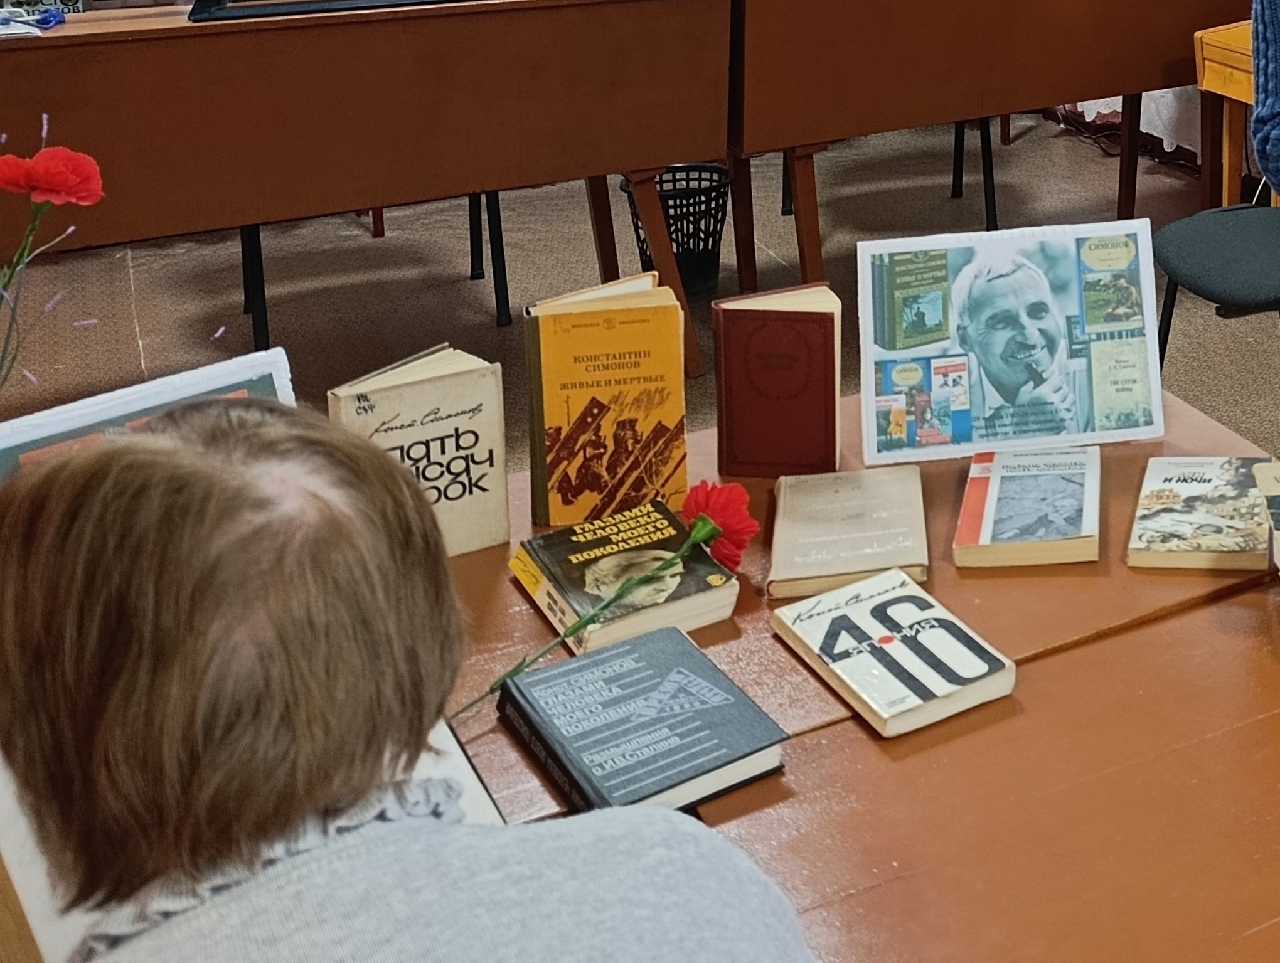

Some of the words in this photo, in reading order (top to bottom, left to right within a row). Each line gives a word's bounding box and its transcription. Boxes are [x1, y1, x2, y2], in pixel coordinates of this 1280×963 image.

[573, 350, 651, 364] КОНСТАНТИН
[585, 360, 641, 372] СИМОНОВ
[560, 380, 602, 390] ЖИВЫЕ
[604, 379, 612, 387] И
[613, 375, 666, 386] МЕРТВЫЕ
[570, 512, 664, 543] ЧЕЛОВЕКА
[572, 503, 656, 535] ГЛАЗАМИ
[609, 519, 670, 544] МОЕГО
[568, 526, 677, 564] ПОКОЛЕНИЯ
[570, 658, 637, 685] СИМОНОВ
[539, 681, 606, 707] ГЛАЗАМИ
[546, 687, 624, 717] ЧЕЛОВЕКА
[552, 704, 604, 728] МОЕГО
[560, 699, 648, 737] ПОКОЛЕНИЯ
[582, 727, 671, 765] Размышления
